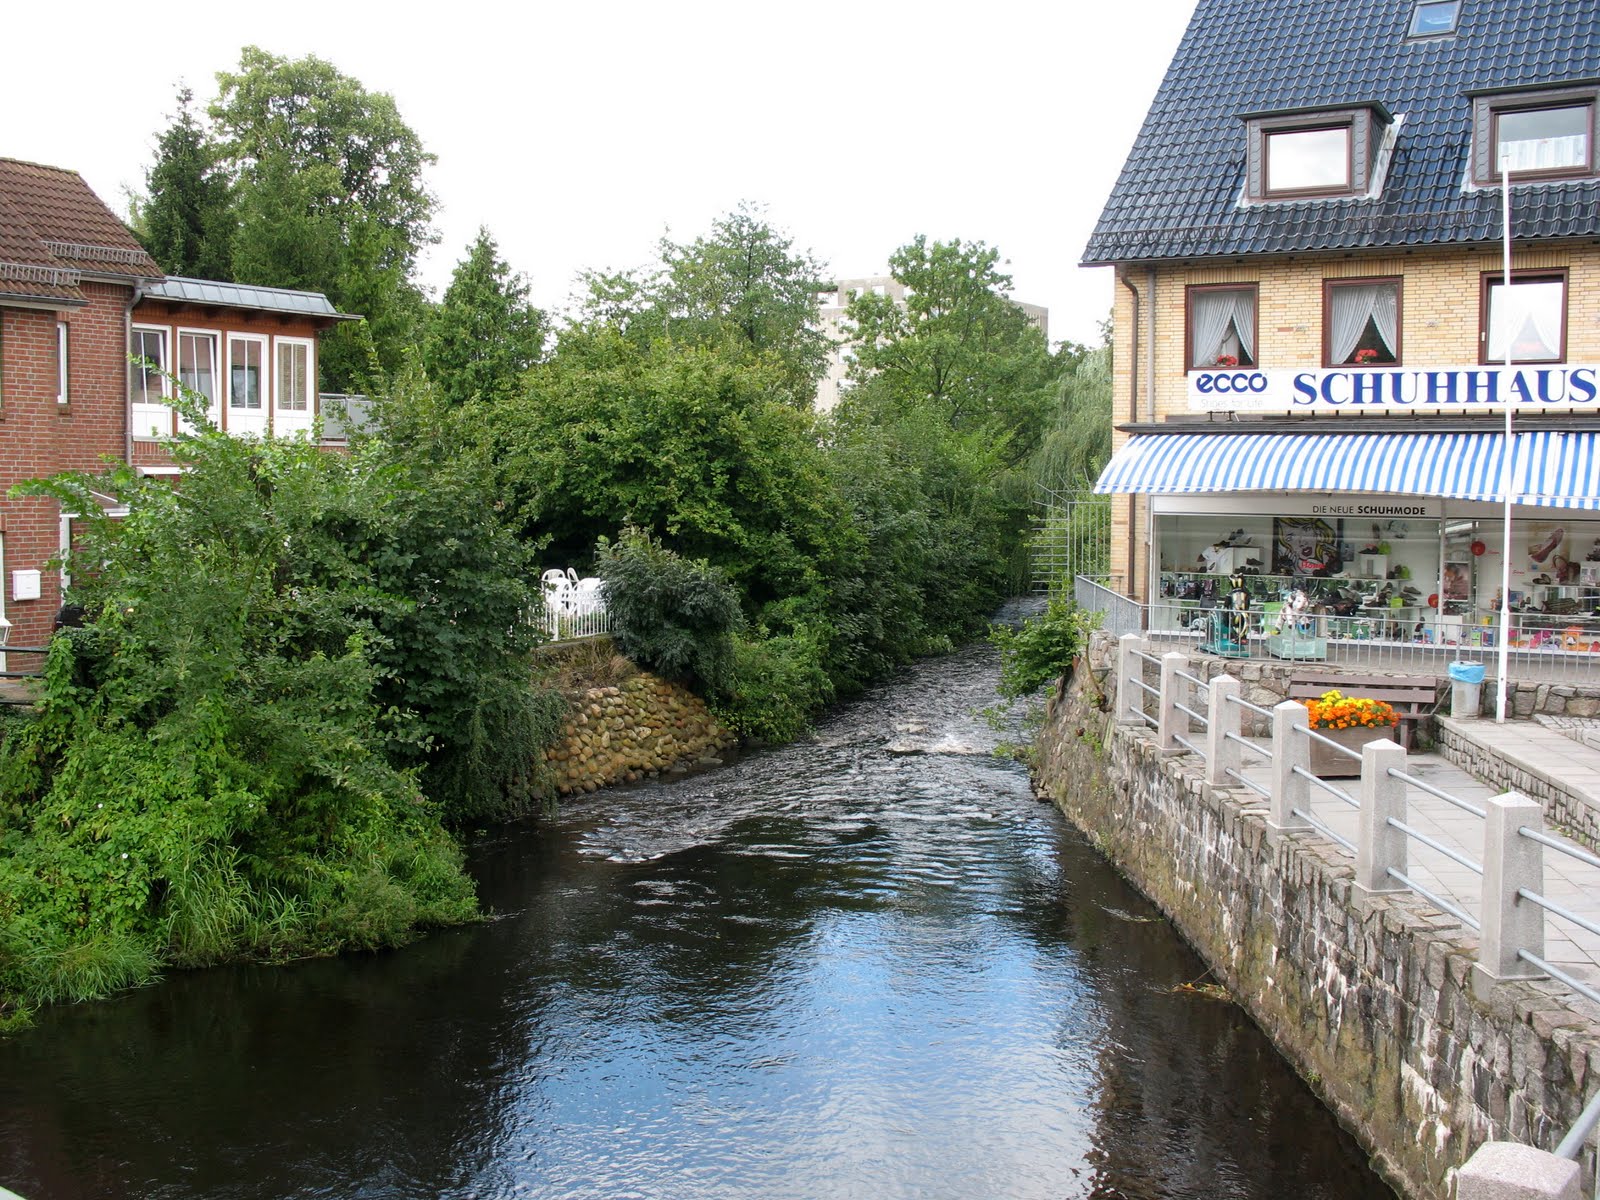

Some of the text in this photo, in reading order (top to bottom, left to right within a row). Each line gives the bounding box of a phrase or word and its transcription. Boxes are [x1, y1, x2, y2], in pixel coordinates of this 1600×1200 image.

[1196, 372, 1268, 393] ecco
[1293, 368, 1597, 406] SCHUHHAUS
[1312, 505, 1426, 515] DIE NEUE SCHUHMODE
